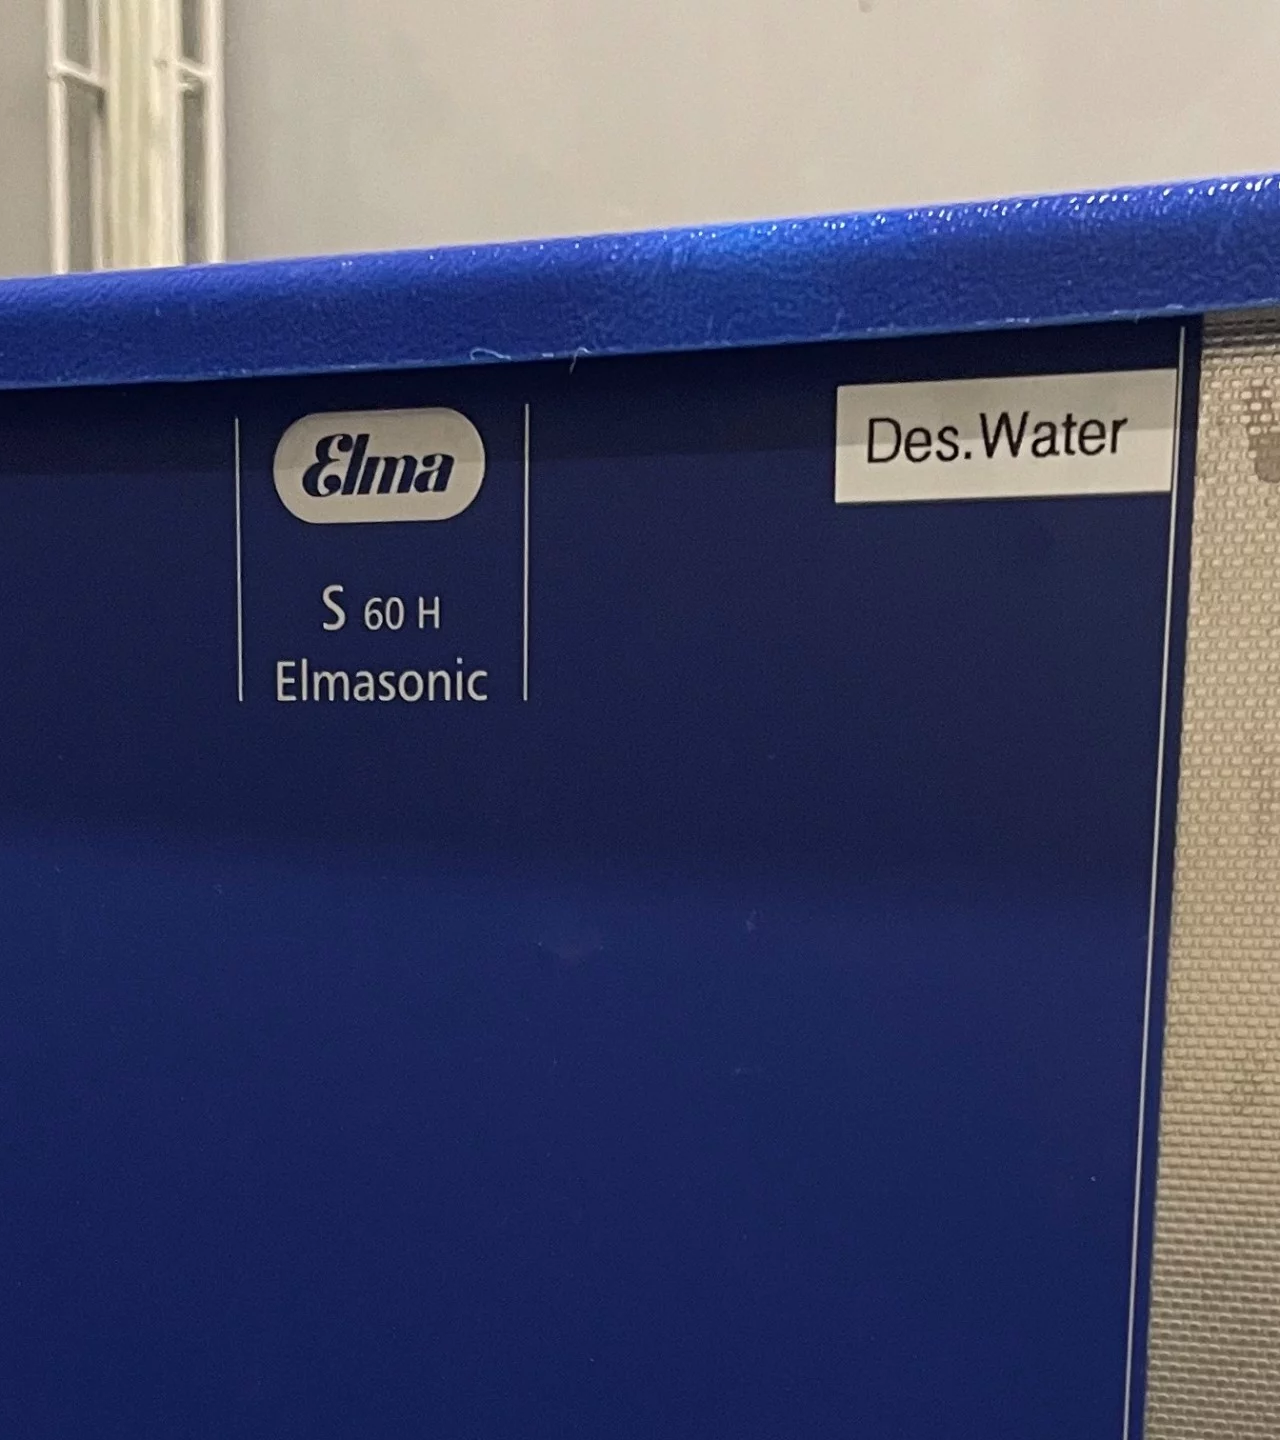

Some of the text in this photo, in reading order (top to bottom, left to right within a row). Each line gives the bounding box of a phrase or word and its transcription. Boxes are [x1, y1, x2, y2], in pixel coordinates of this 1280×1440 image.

[302, 432, 455, 497] Elma
[322, 584, 440, 631] S 60 H
[276, 657, 488, 702] Elmasonic
